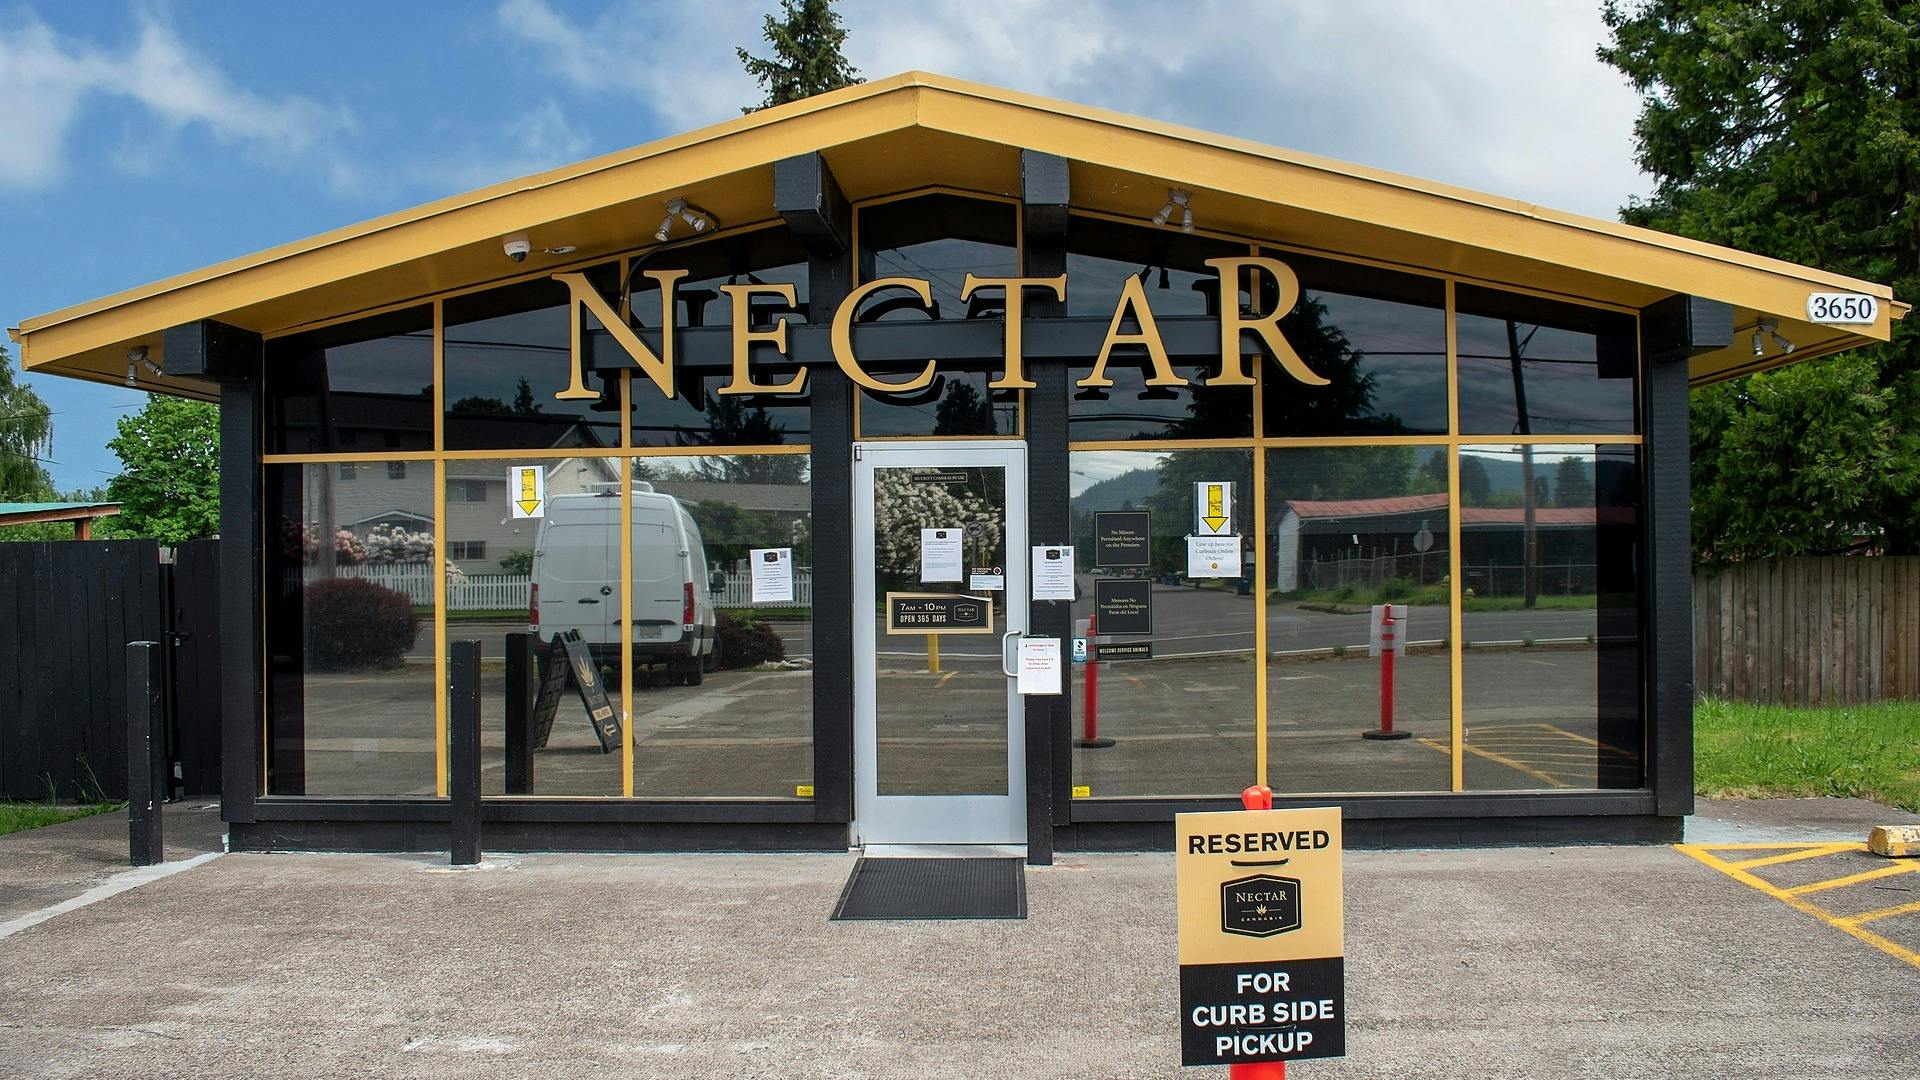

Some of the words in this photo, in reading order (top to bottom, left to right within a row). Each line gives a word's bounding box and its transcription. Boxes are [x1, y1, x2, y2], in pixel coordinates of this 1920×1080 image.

[1814, 297, 1872, 319] 3650
[551, 256, 1331, 402] NECTAR
[900, 603, 916, 611] 7AM
[924, 603, 946, 611] 10PM
[900, 614, 916, 622] OPEN
[918, 614, 930, 622] 365
[932, 614, 946, 622] DAYS
[1188, 830, 1330, 854] RESERVED
[1235, 890, 1288, 902] NECTAR
[1237, 972, 1290, 994] FOR
[1192, 1004, 1266, 1027] CURB
[1273, 999, 1334, 1023] SIDE
[1216, 1031, 1313, 1056] PICKUP
